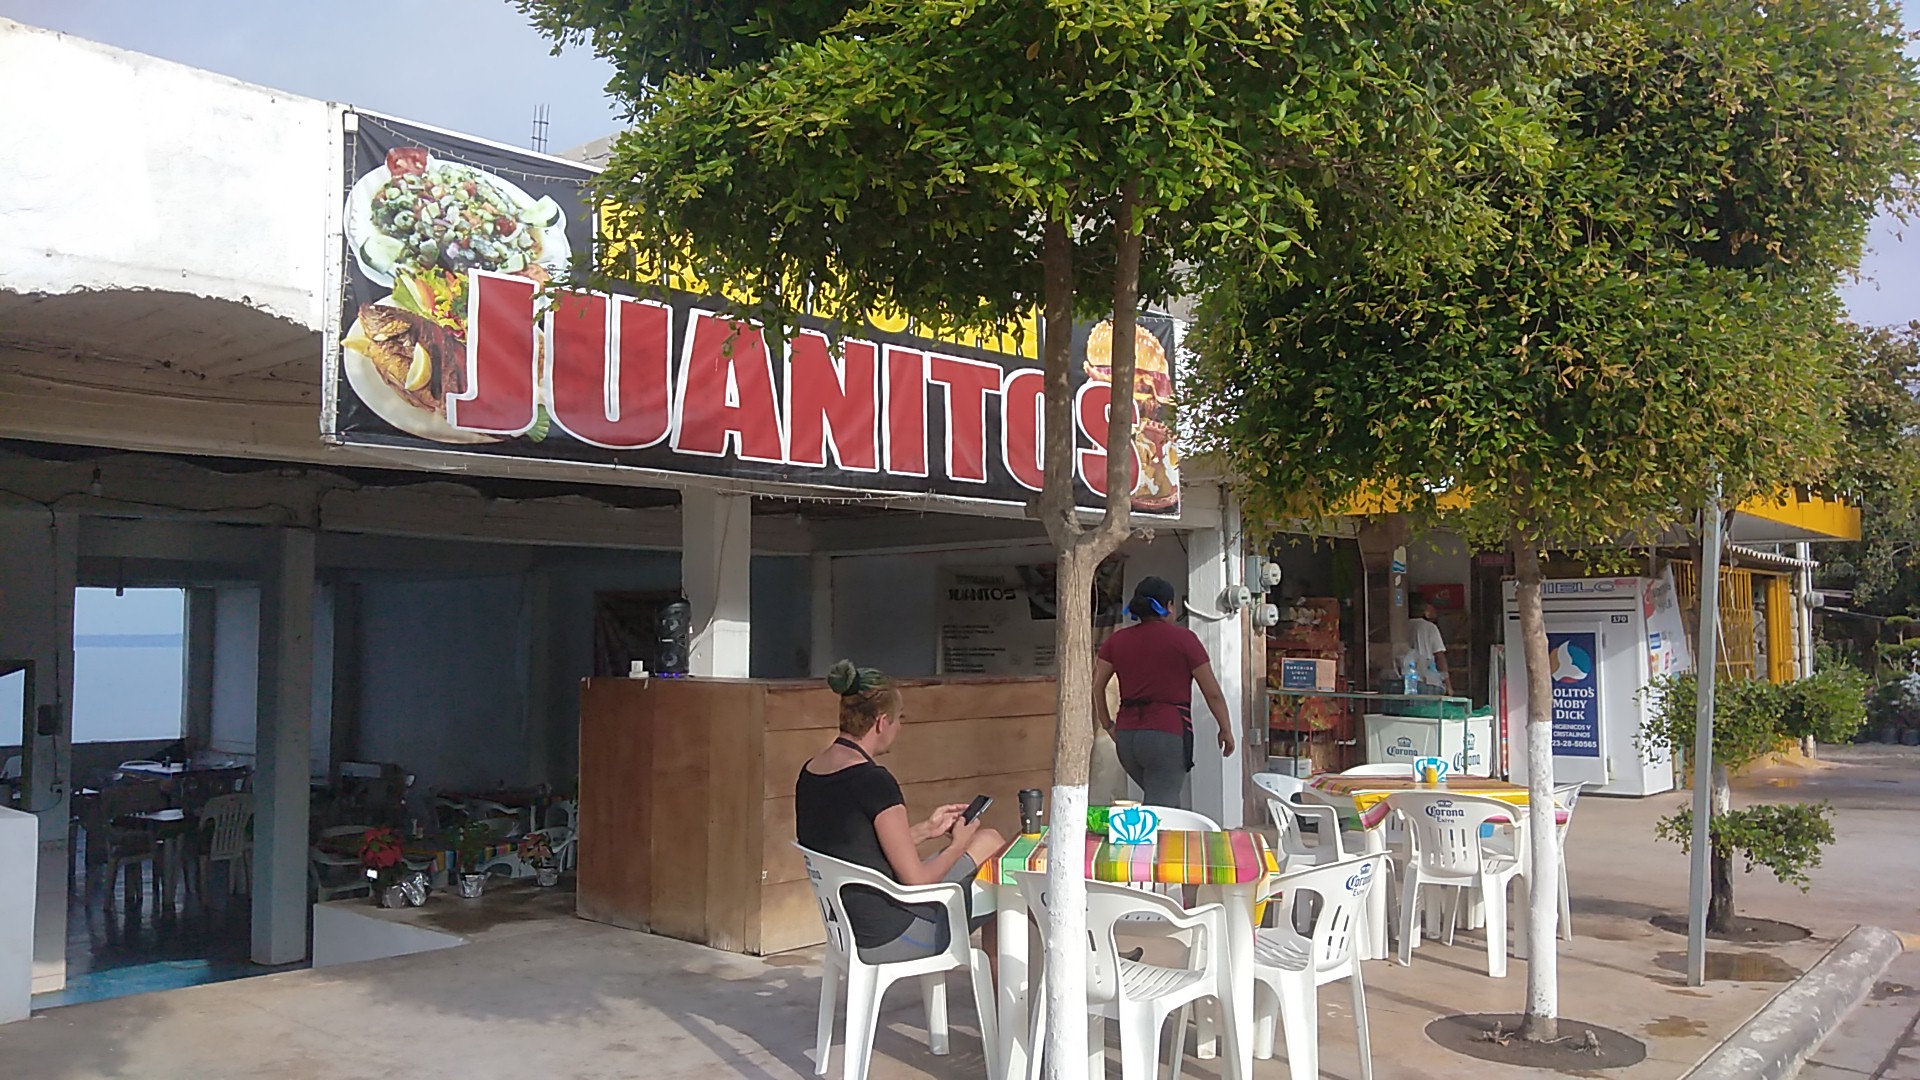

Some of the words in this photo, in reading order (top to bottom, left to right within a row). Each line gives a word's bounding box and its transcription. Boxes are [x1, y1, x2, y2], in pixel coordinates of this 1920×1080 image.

[446, 267, 1142, 499] JUANITOS
[1541, 581, 1615, 594] IELO
[1612, 615, 1627, 623] 170
[1553, 687, 1595, 698] OLITO'S
[1553, 698, 1588, 709] MOBY
[1556, 709, 1585, 720] DICK
[1551, 739, 1597, 748] 23-28-50565
[1387, 745, 1419, 757] Corona
[1453, 752, 1480, 773] Coona
[1425, 805, 1465, 818] Corona
